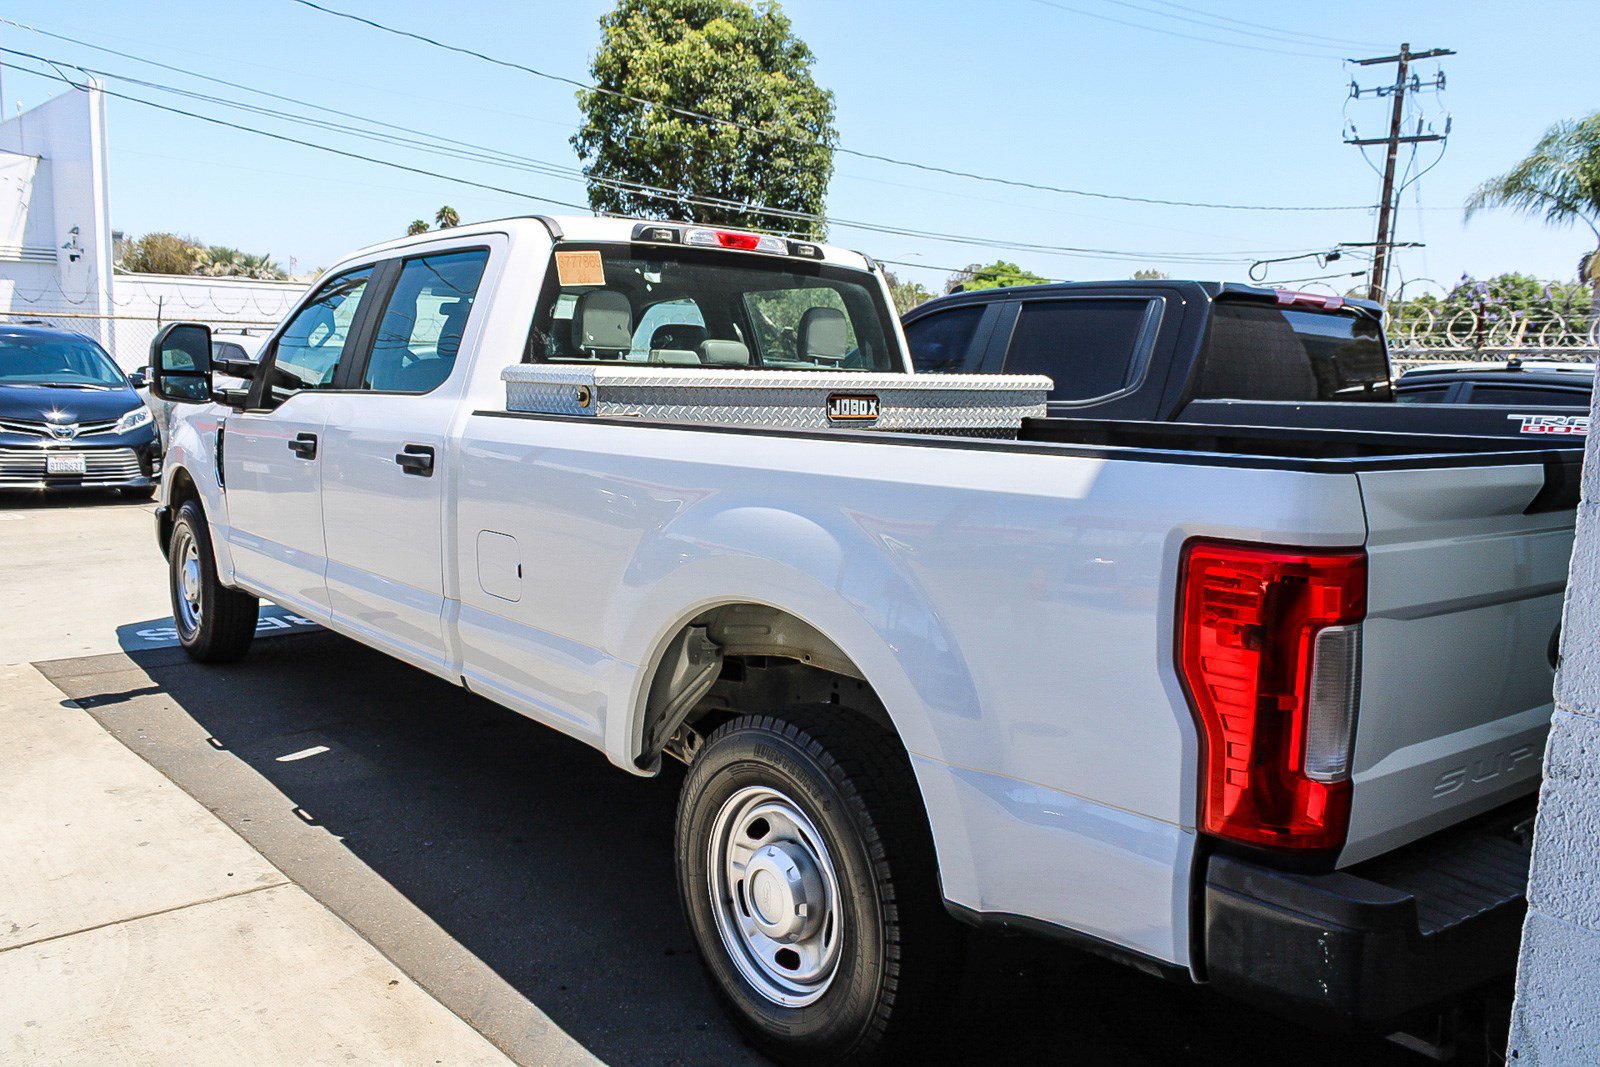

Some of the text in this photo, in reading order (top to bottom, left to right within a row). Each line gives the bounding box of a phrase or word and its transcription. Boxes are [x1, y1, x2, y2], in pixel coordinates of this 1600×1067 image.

[831, 399, 878, 416] JOBOX
[1507, 414, 1590, 427] TRA
[1432, 744, 1544, 799] SUP
